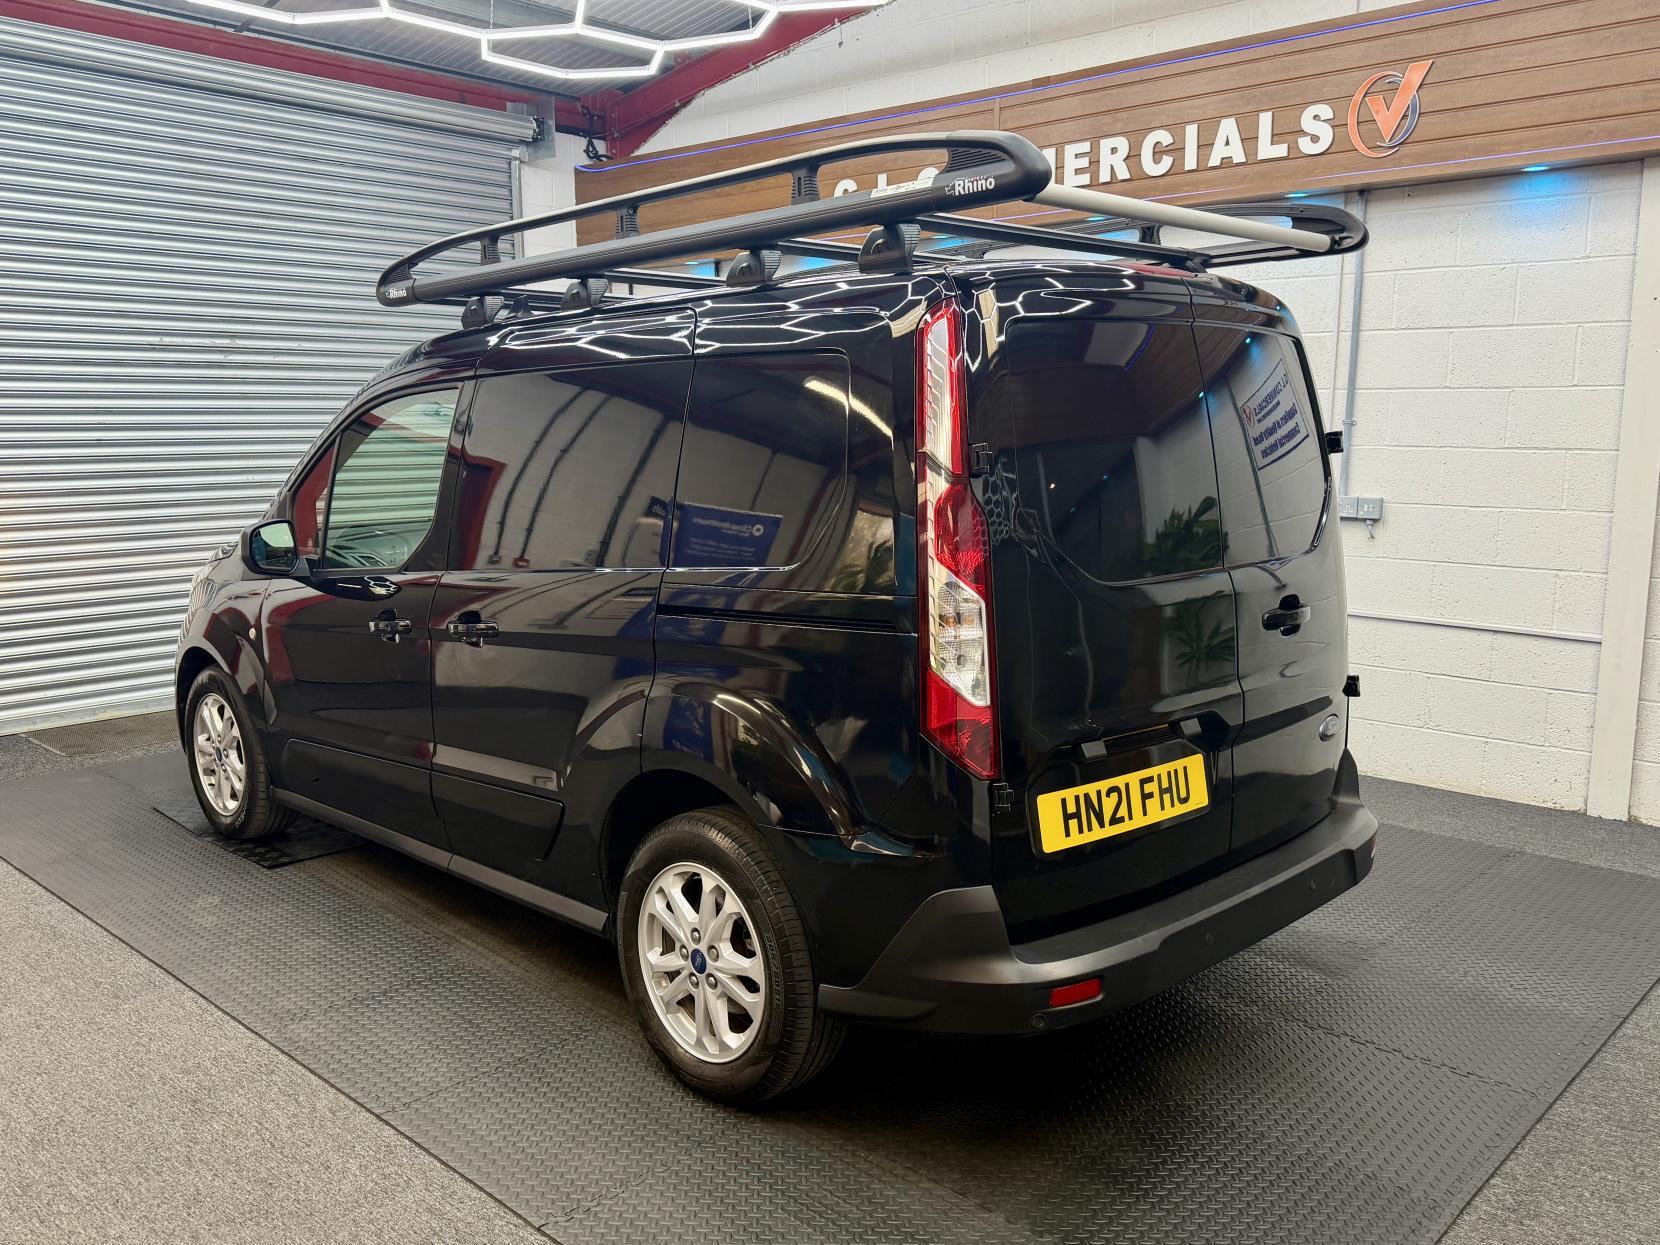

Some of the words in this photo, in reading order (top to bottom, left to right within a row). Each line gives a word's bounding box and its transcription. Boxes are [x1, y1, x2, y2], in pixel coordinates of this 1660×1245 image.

[954, 176, 995, 196] Rhino
[1060, 781, 1134, 839] HN21
[1139, 765, 1191, 817] FHU
